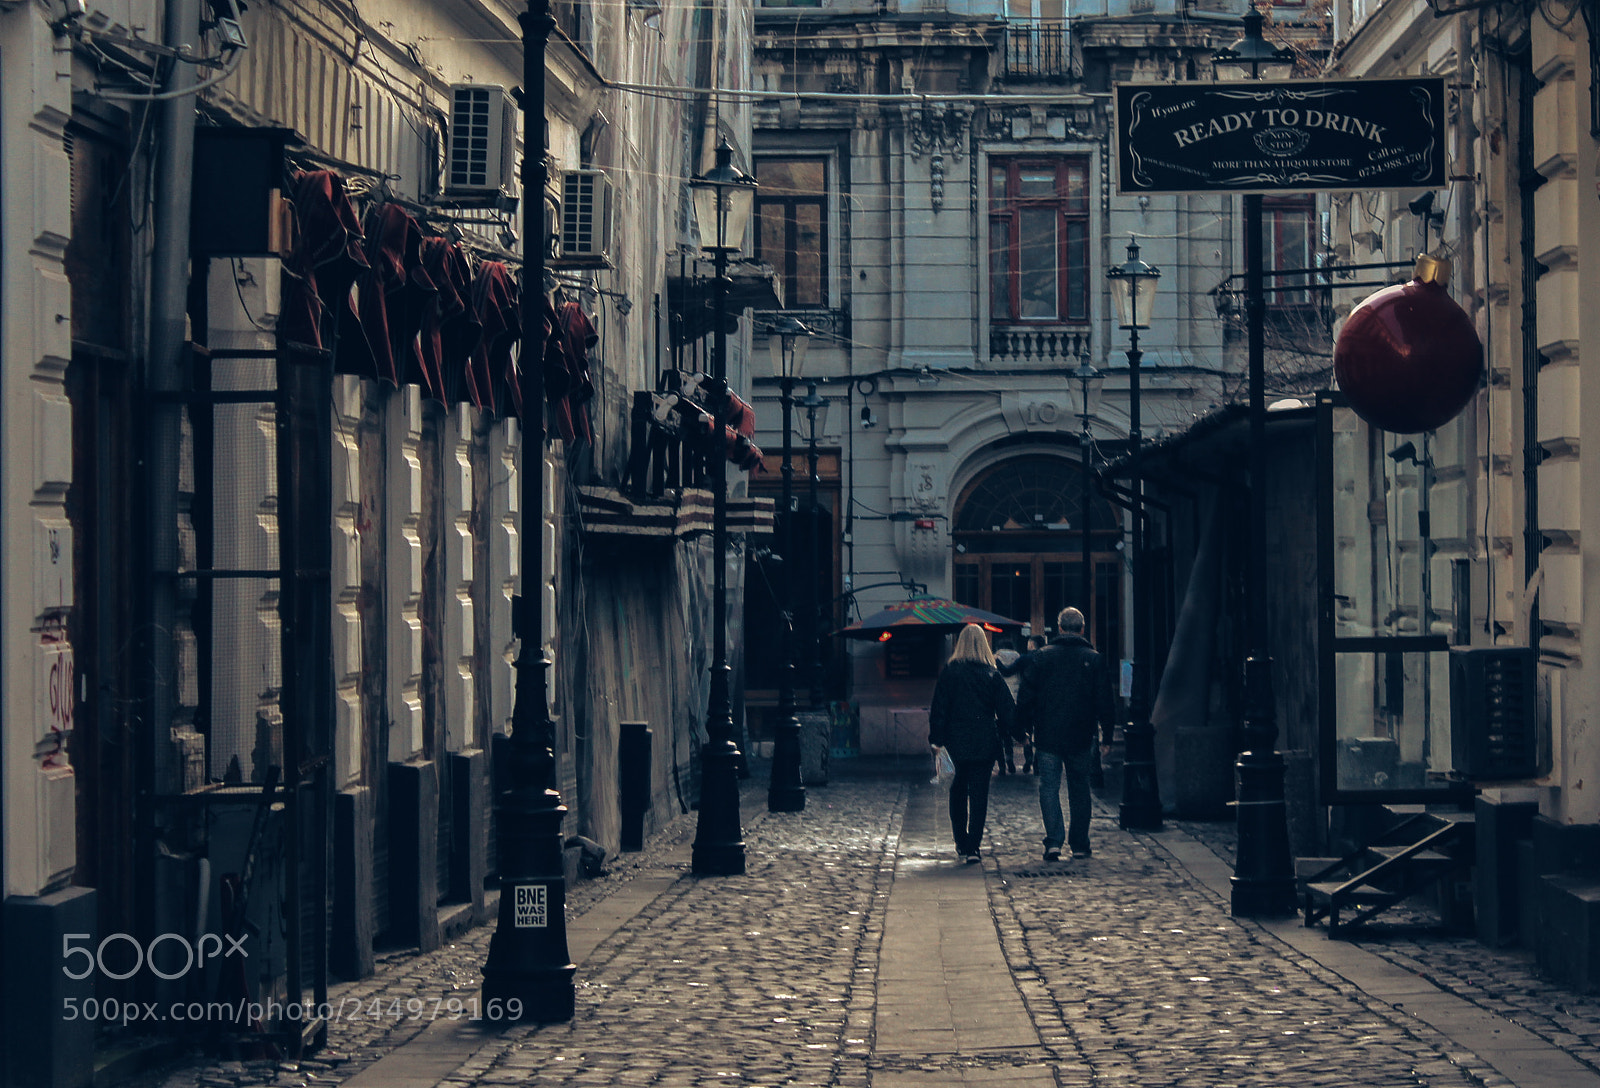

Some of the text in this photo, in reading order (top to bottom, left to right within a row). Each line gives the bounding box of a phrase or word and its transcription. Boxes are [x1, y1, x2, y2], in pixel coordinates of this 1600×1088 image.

[1151, 99, 1197, 118] If you are
[1173, 108, 1387, 148] READY TO DRINK
[1270, 131, 1291, 139] NON
[1269, 141, 1294, 149] STOP
[1367, 146, 1405, 161] Call us:
[1212, 158, 1352, 169] MORE THAN A LIQOUR STORE
[517, 888, 545, 905] BNE
[517, 905, 545, 915] WAS
[517, 915, 545, 925] HERE
